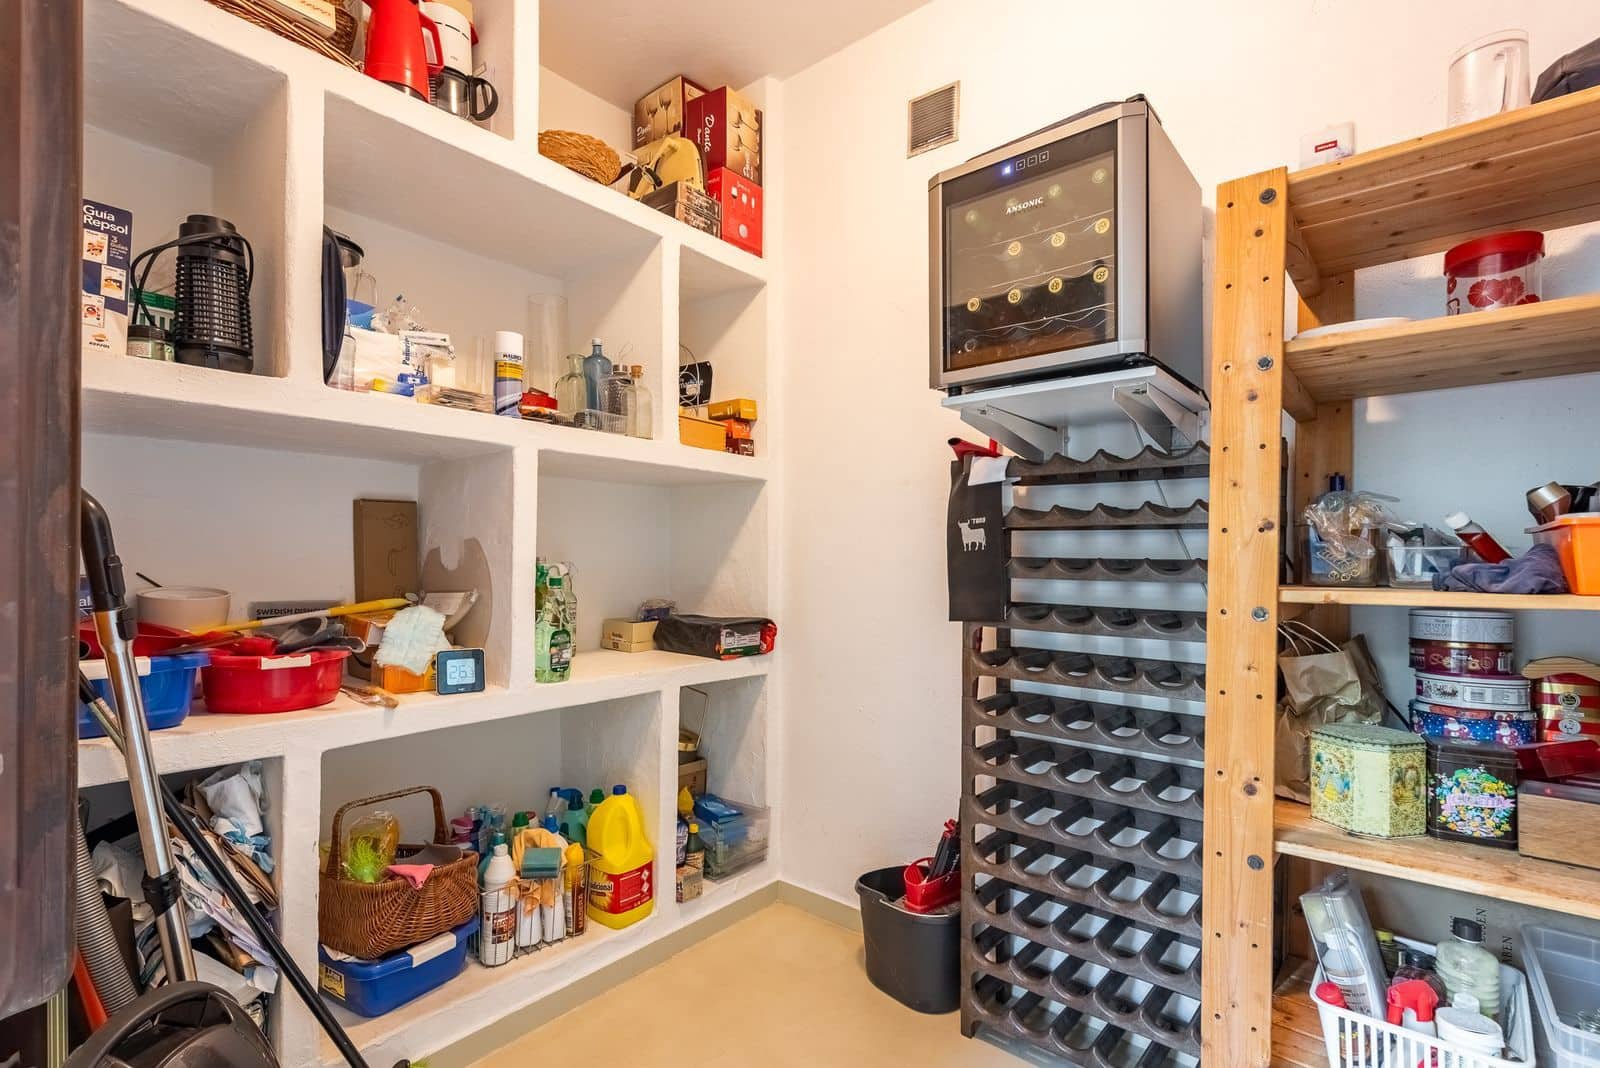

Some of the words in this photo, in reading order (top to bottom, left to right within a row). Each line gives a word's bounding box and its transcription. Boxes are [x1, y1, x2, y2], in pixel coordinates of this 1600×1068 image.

[1006, 196, 1043, 215] ANSONIC
[84, 214, 128, 235] Repsol
[256, 607, 293, 615] SWEDISH
